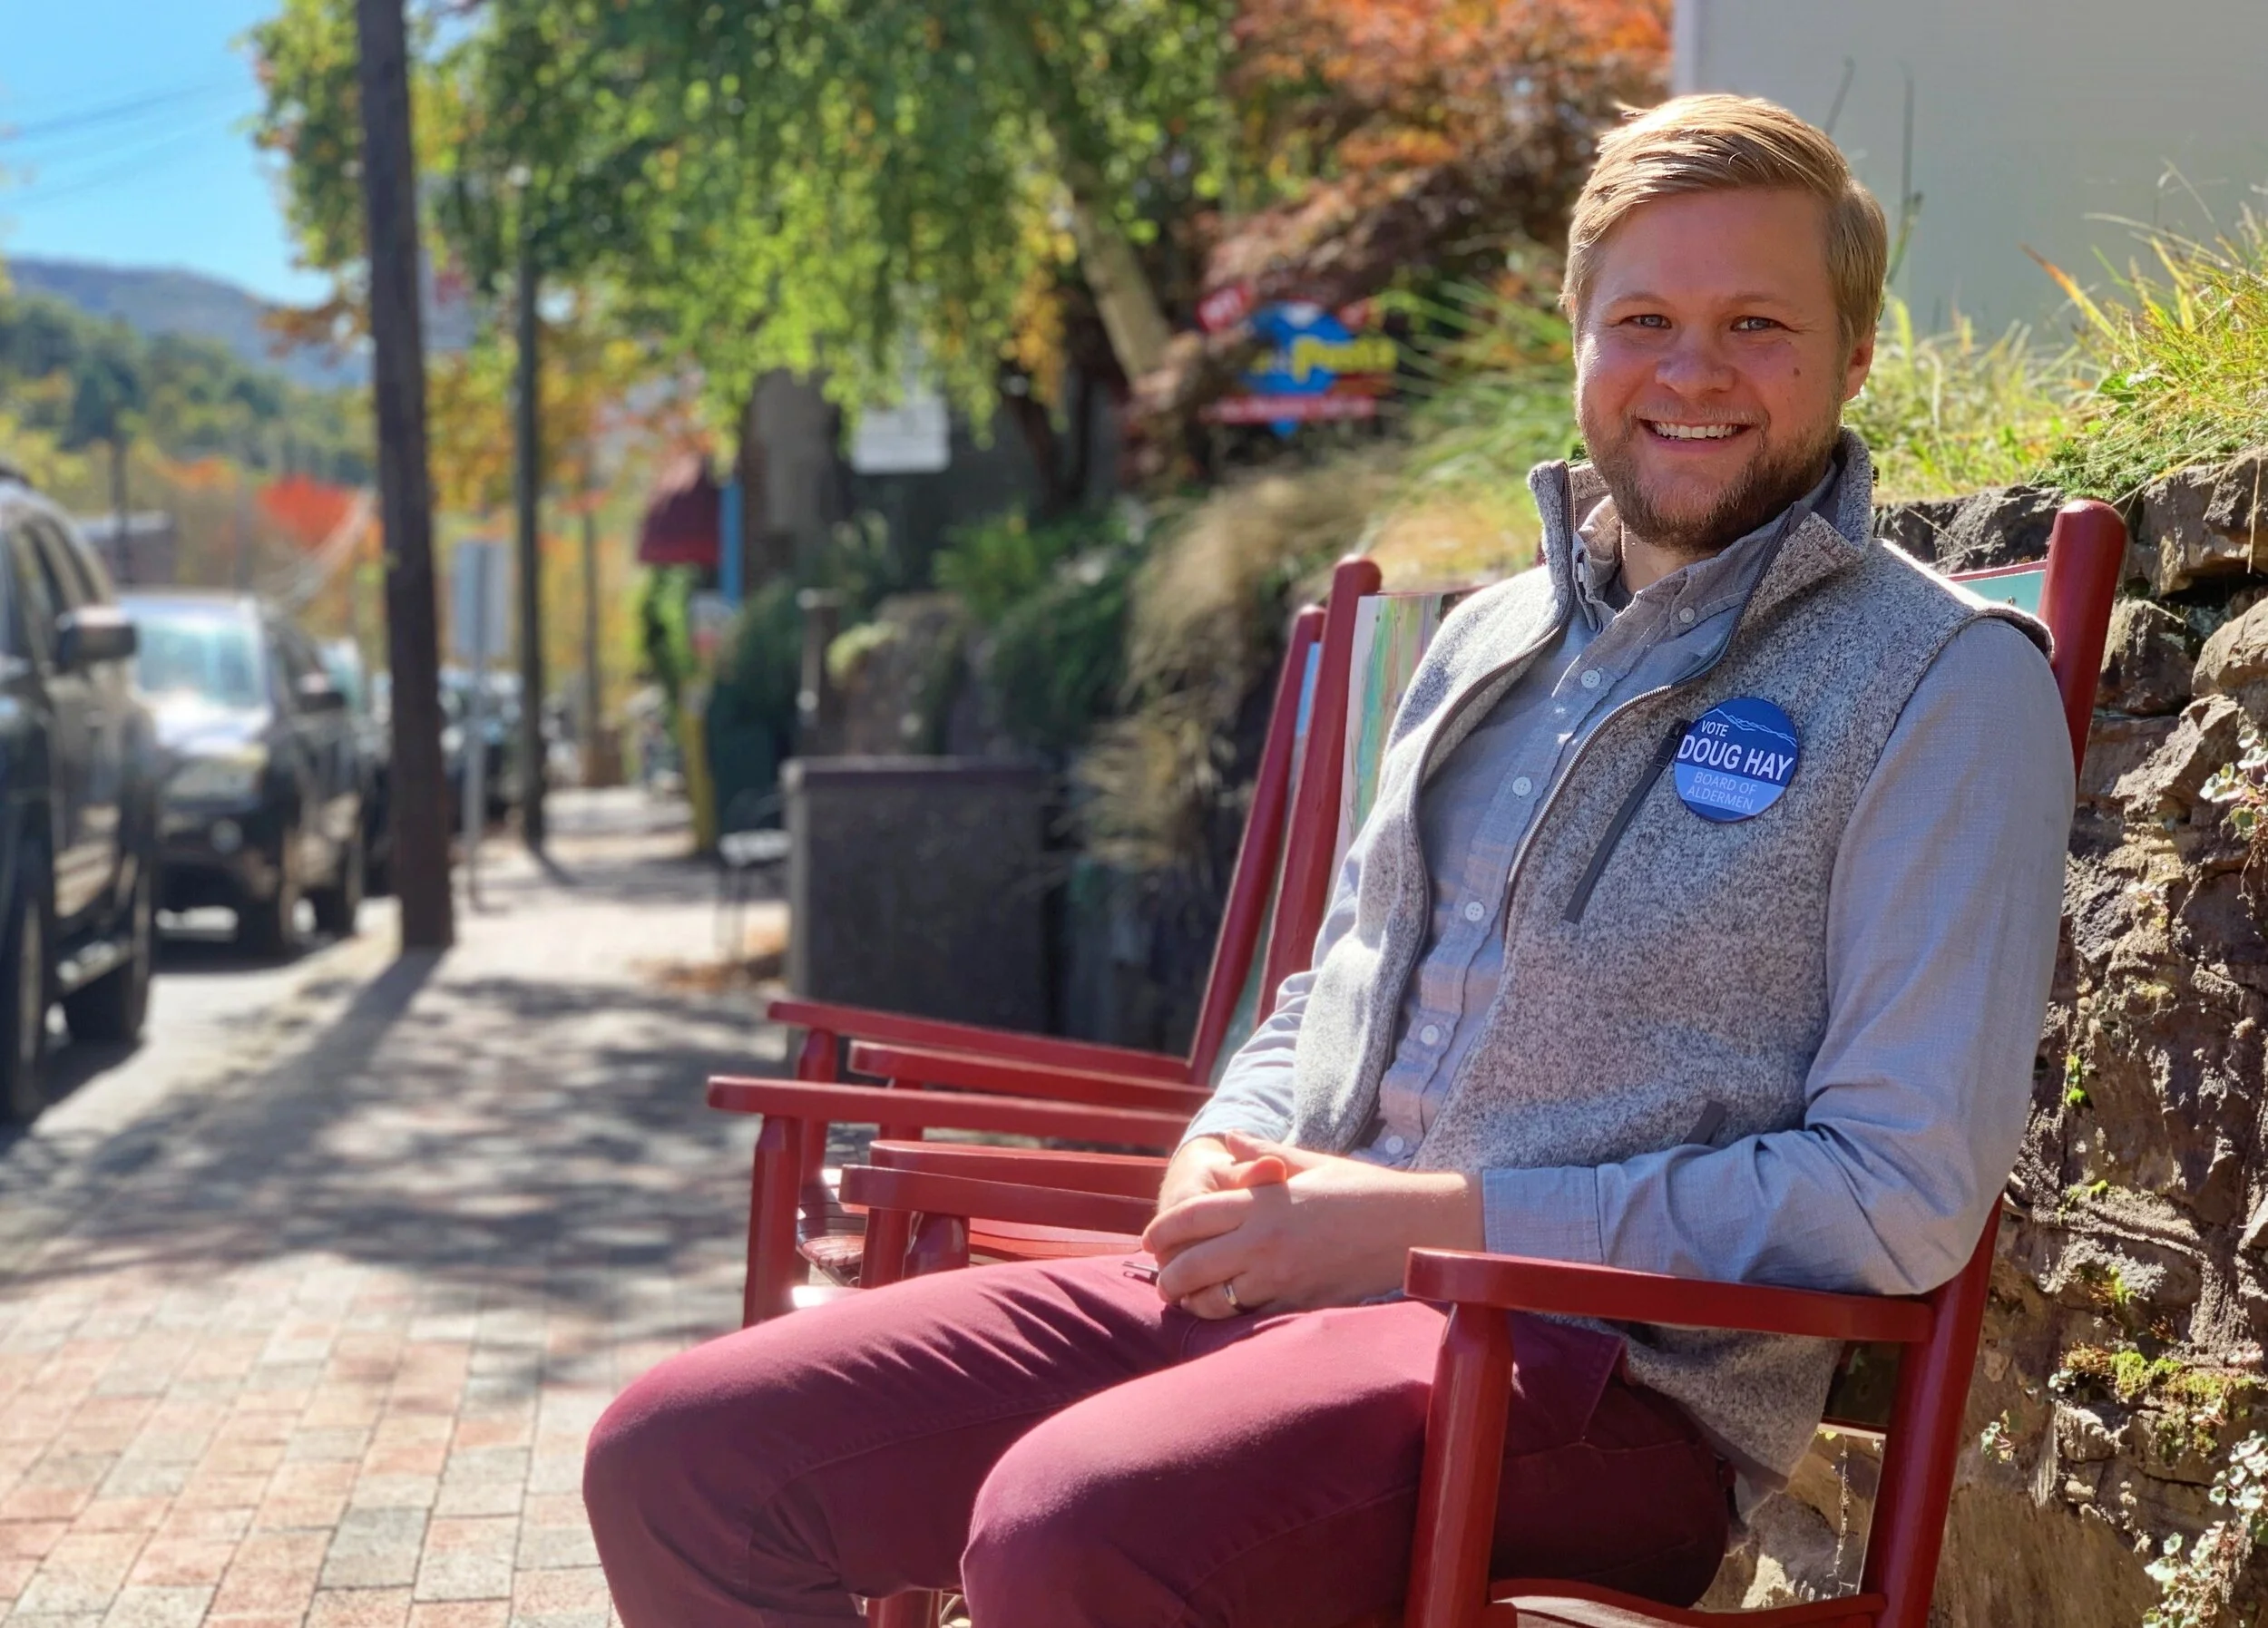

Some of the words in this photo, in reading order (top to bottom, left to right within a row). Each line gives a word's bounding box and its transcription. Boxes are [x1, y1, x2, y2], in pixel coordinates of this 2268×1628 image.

[1701, 720, 1729, 737] VOTE
[1677, 735, 1742, 770] DOUG
[1743, 748, 1794, 781] HAY
[1694, 772, 1736, 791] BOARD
[1739, 782, 1758, 795] OF
[1686, 785, 1755, 810] ALDERMEN
